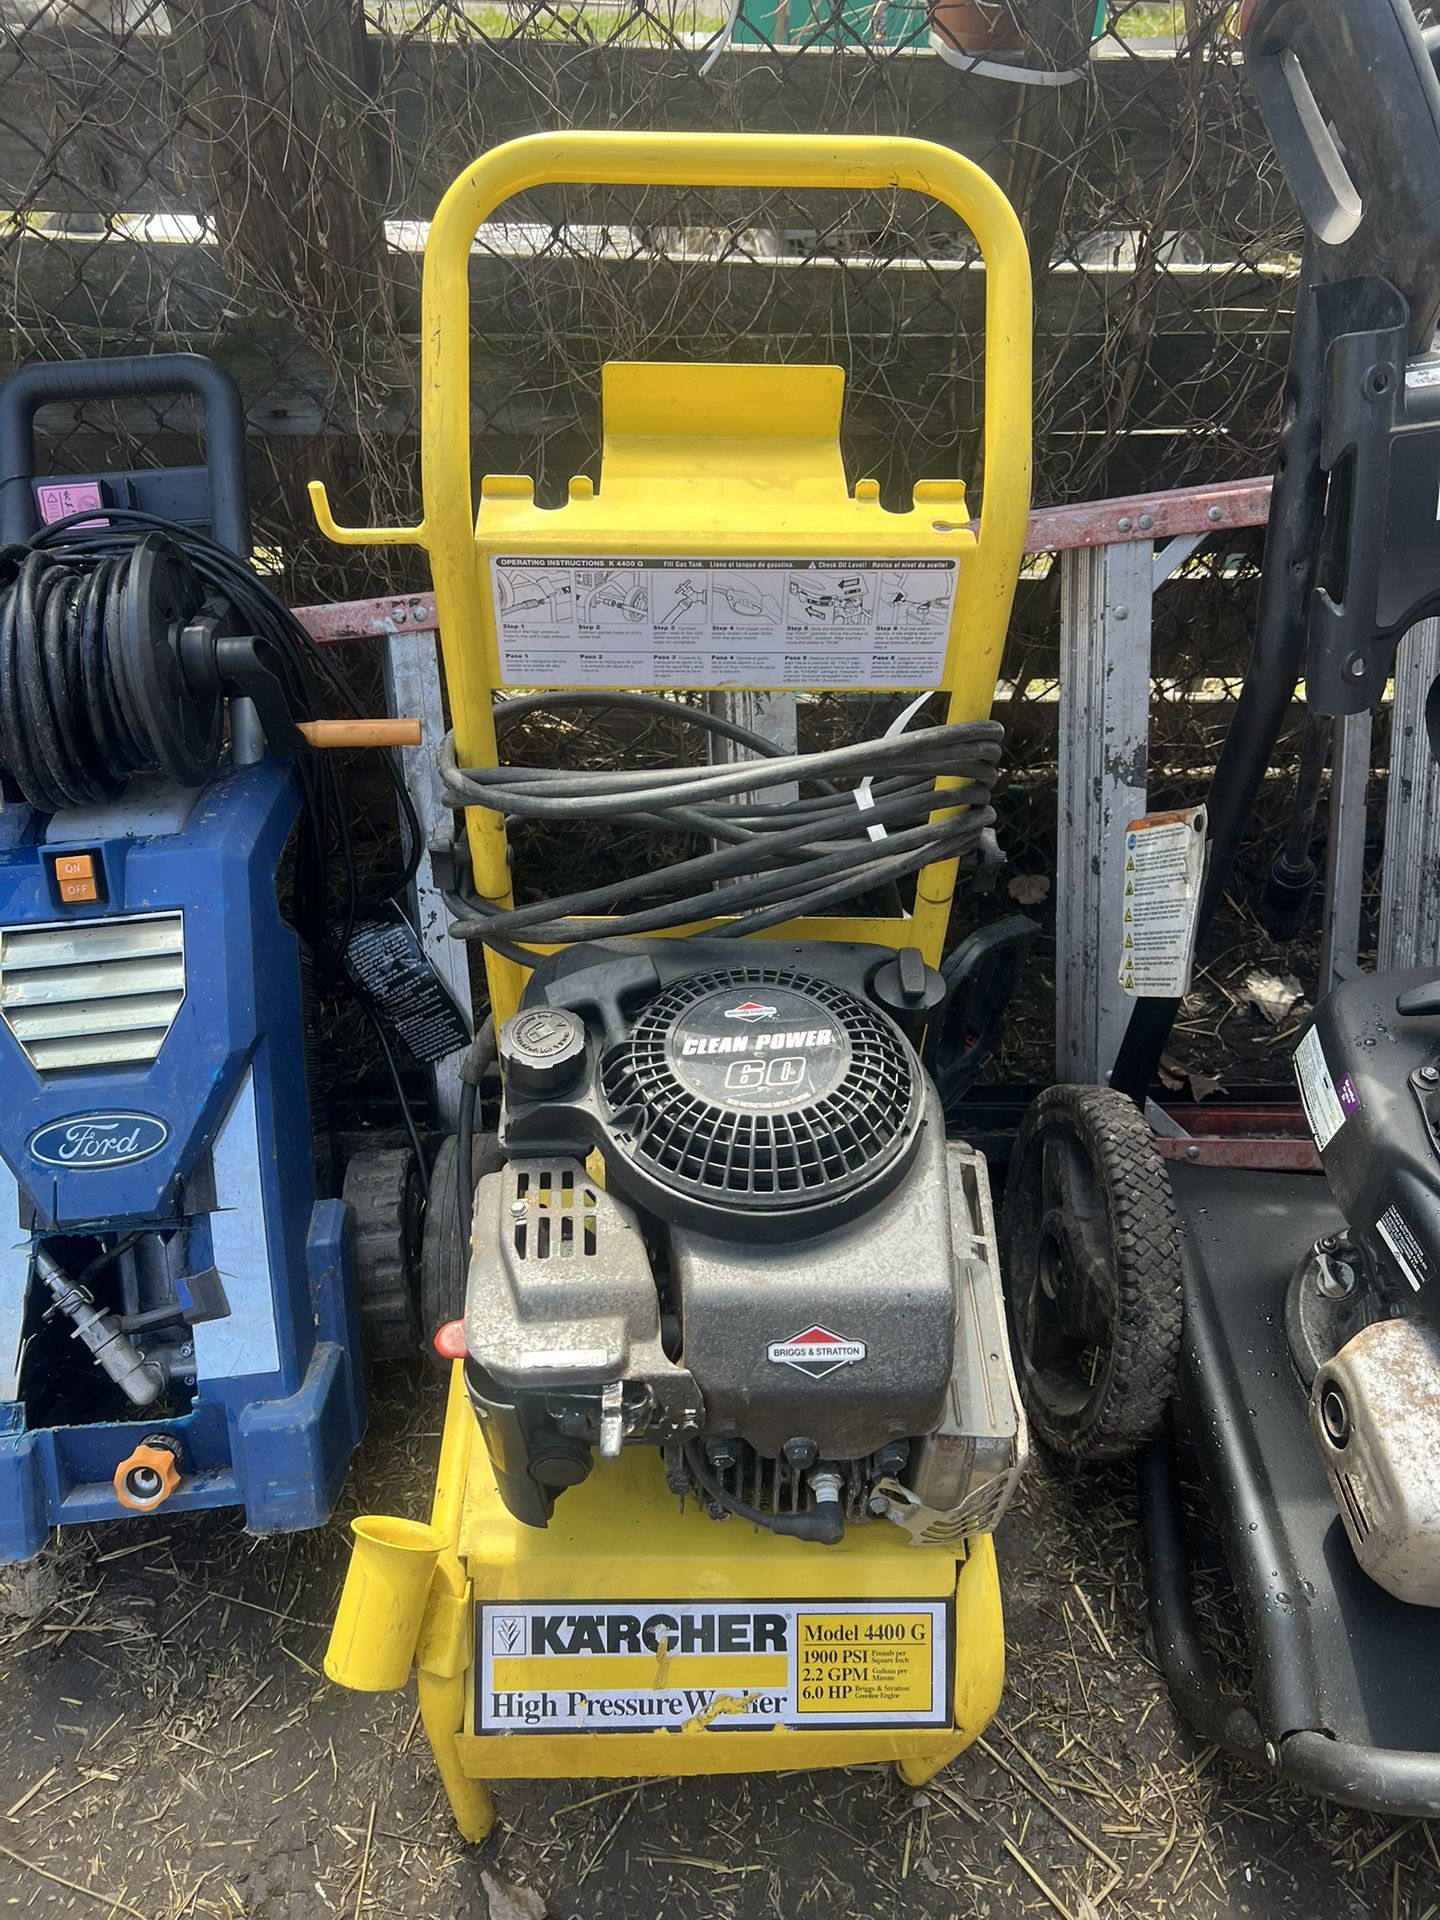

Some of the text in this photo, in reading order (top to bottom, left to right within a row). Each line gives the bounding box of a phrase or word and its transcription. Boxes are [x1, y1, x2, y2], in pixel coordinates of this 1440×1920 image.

[64, 863, 80, 874] ON
[68, 884, 88, 895] OFF
[682, 1029, 832, 1056] CLEAN POWER
[58, 1123, 140, 1160] Ford
[774, 1346, 860, 1356] BRIGGS & STRATTON
[532, 1614, 788, 1656] KÄRCHER
[804, 1624, 926, 1641] Model 4400 G
[804, 1649, 868, 1664] 1900 PSI
[802, 1667, 868, 1682] 2.2 GPM
[802, 1685, 852, 1700] 6.0 HP
[490, 1692, 558, 1723] High
[567, 1692, 682, 1716] Pressure
